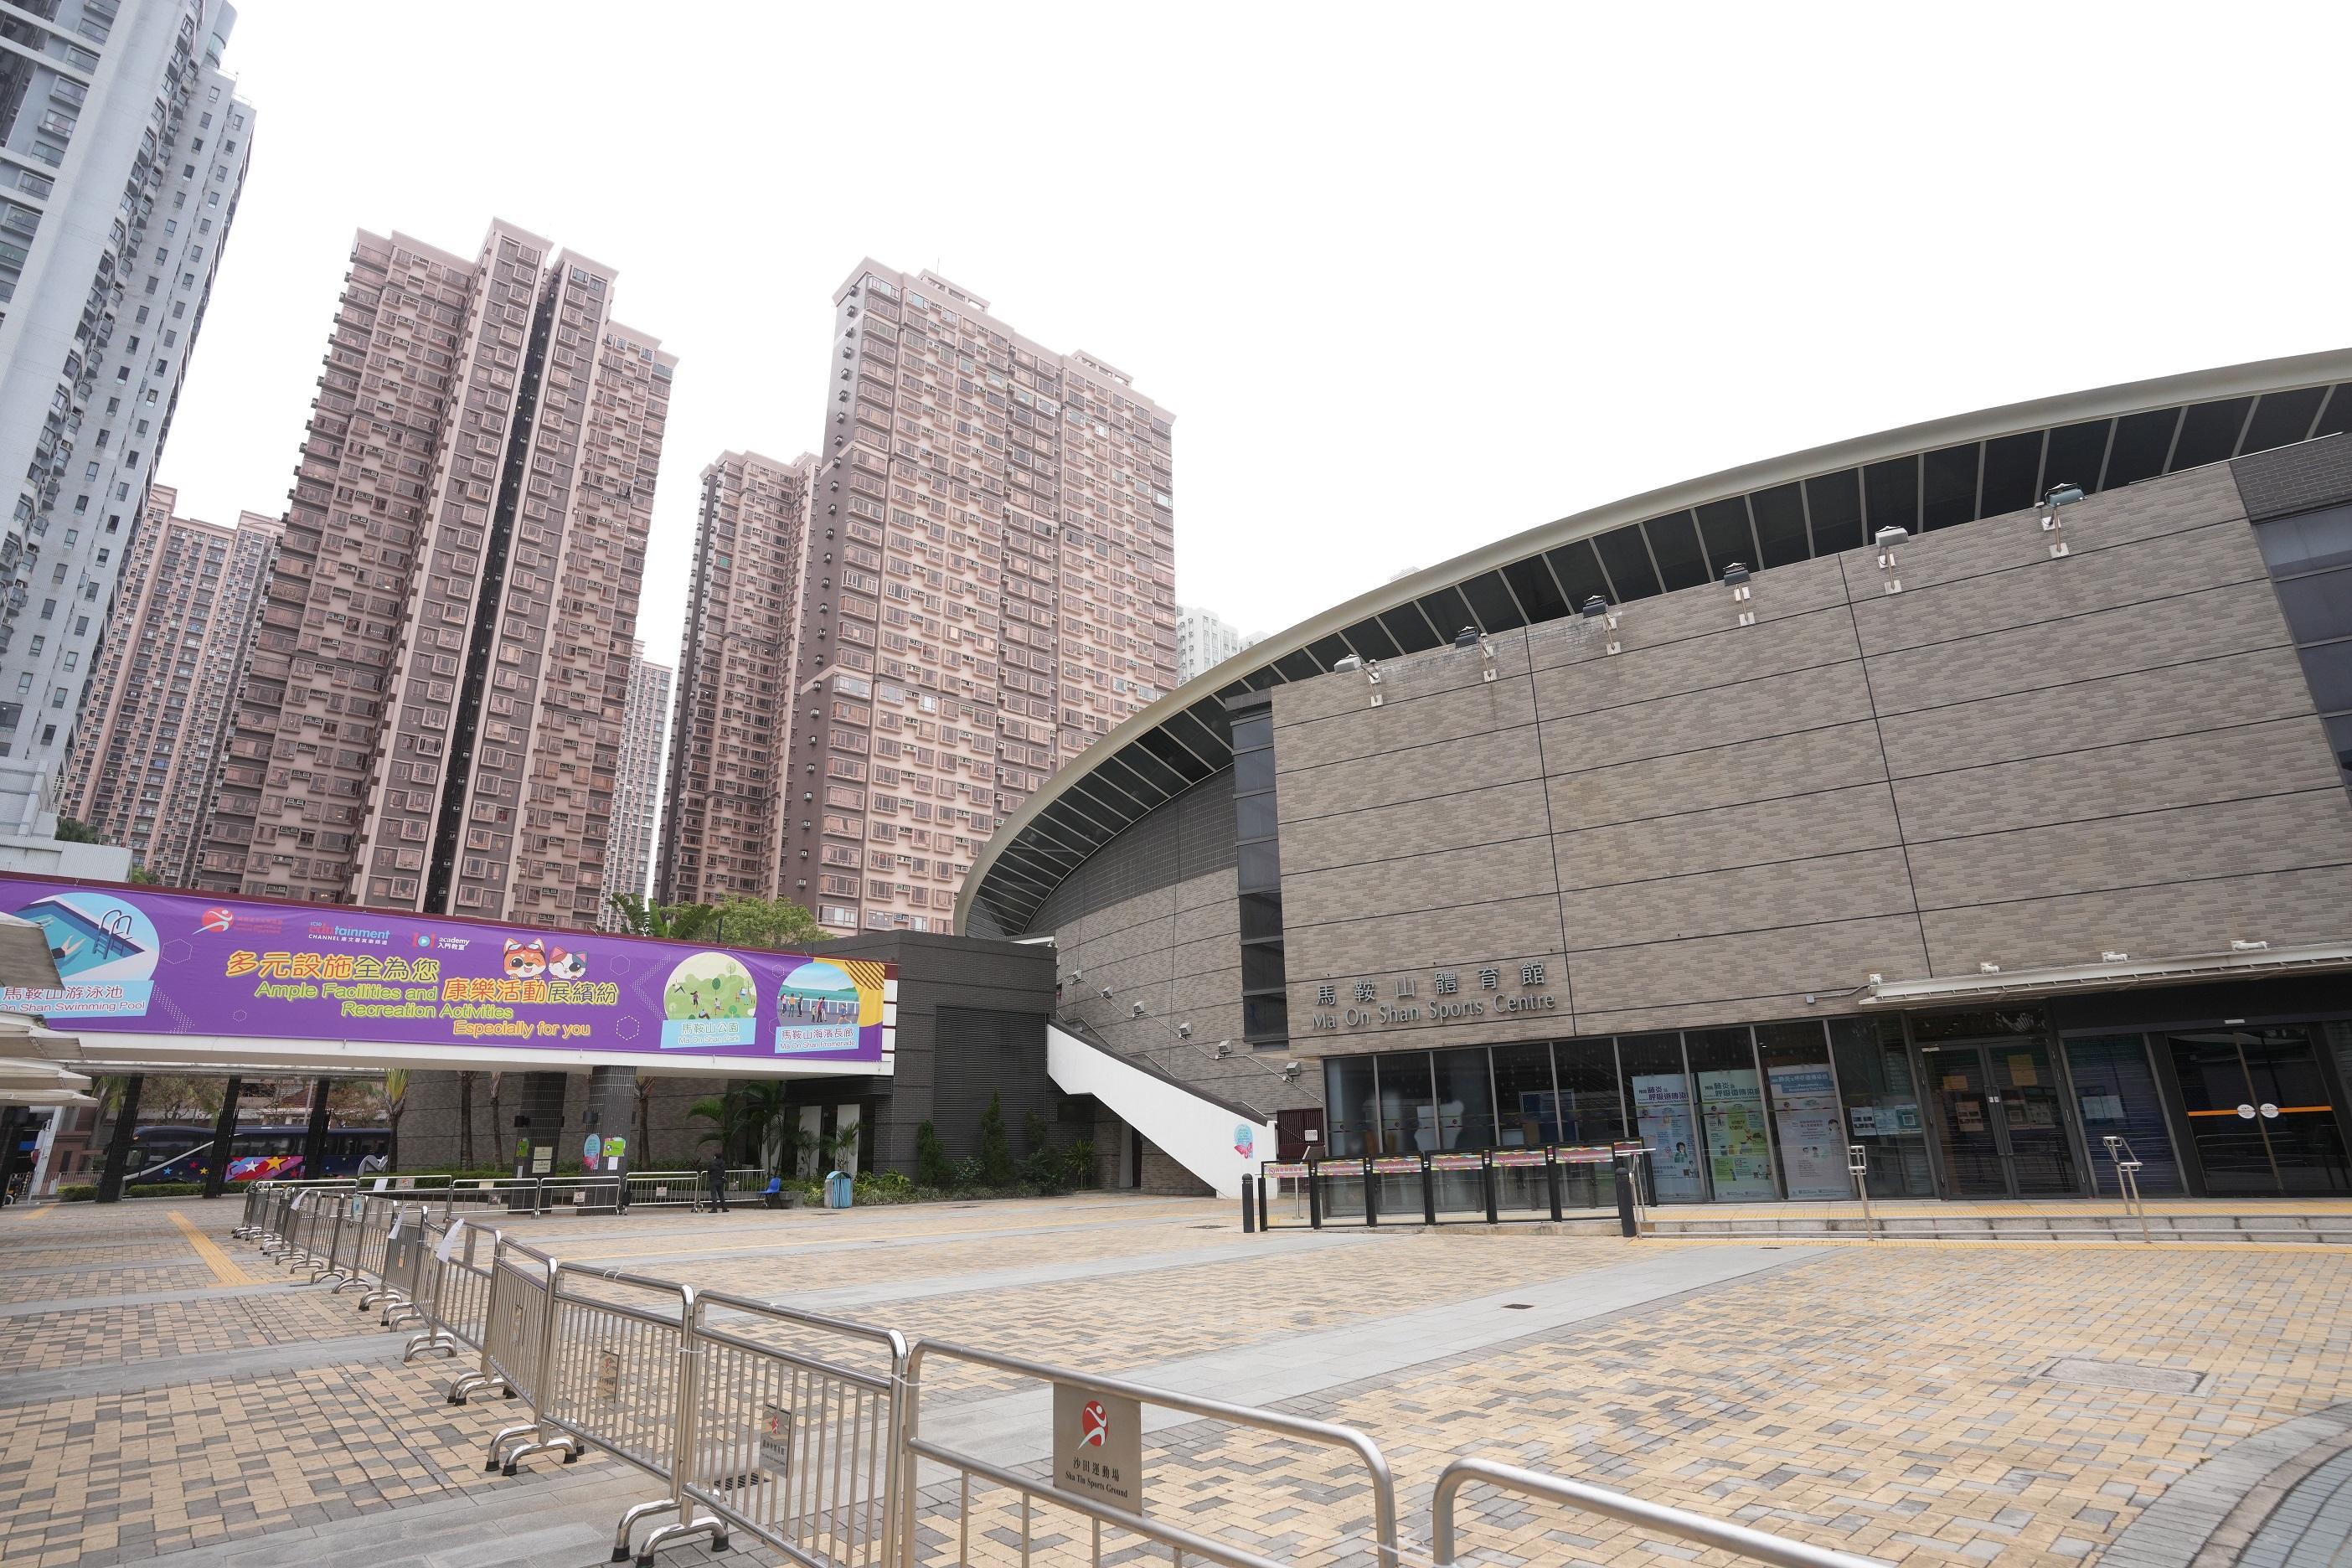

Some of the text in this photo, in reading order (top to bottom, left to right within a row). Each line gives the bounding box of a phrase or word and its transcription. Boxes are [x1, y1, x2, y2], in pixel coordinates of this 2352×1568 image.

[439, 936, 470, 946] academy
[226, 950, 440, 982] 多元設施全為您
[255, 982, 437, 1002] Ample Facilities and
[442, 978, 618, 1004] 康樂活動展繽紛
[1316, 961, 1545, 1006] 馬鞍山體育館
[20, 1003, 51, 1012] Shan
[54, 1002, 119, 1012] Swimming
[120, 1001, 145, 1010] Pool
[341, 1001, 513, 1019] Recreation Activities
[1312, 993, 1555, 1029] Ma On Shan Sports Centre
[453, 1020, 591, 1038] Especially for you
[682, 1022, 739, 1034] 馬鞍山公園
[781, 1027, 854, 1040] 馬鞍山海濱長廊
[820, 1039, 855, 1047] Promenade
[1073, 1457, 1120, 1482] 沙田運動場
[1065, 1470, 1128, 1498] Sha Tin Sports Ground
